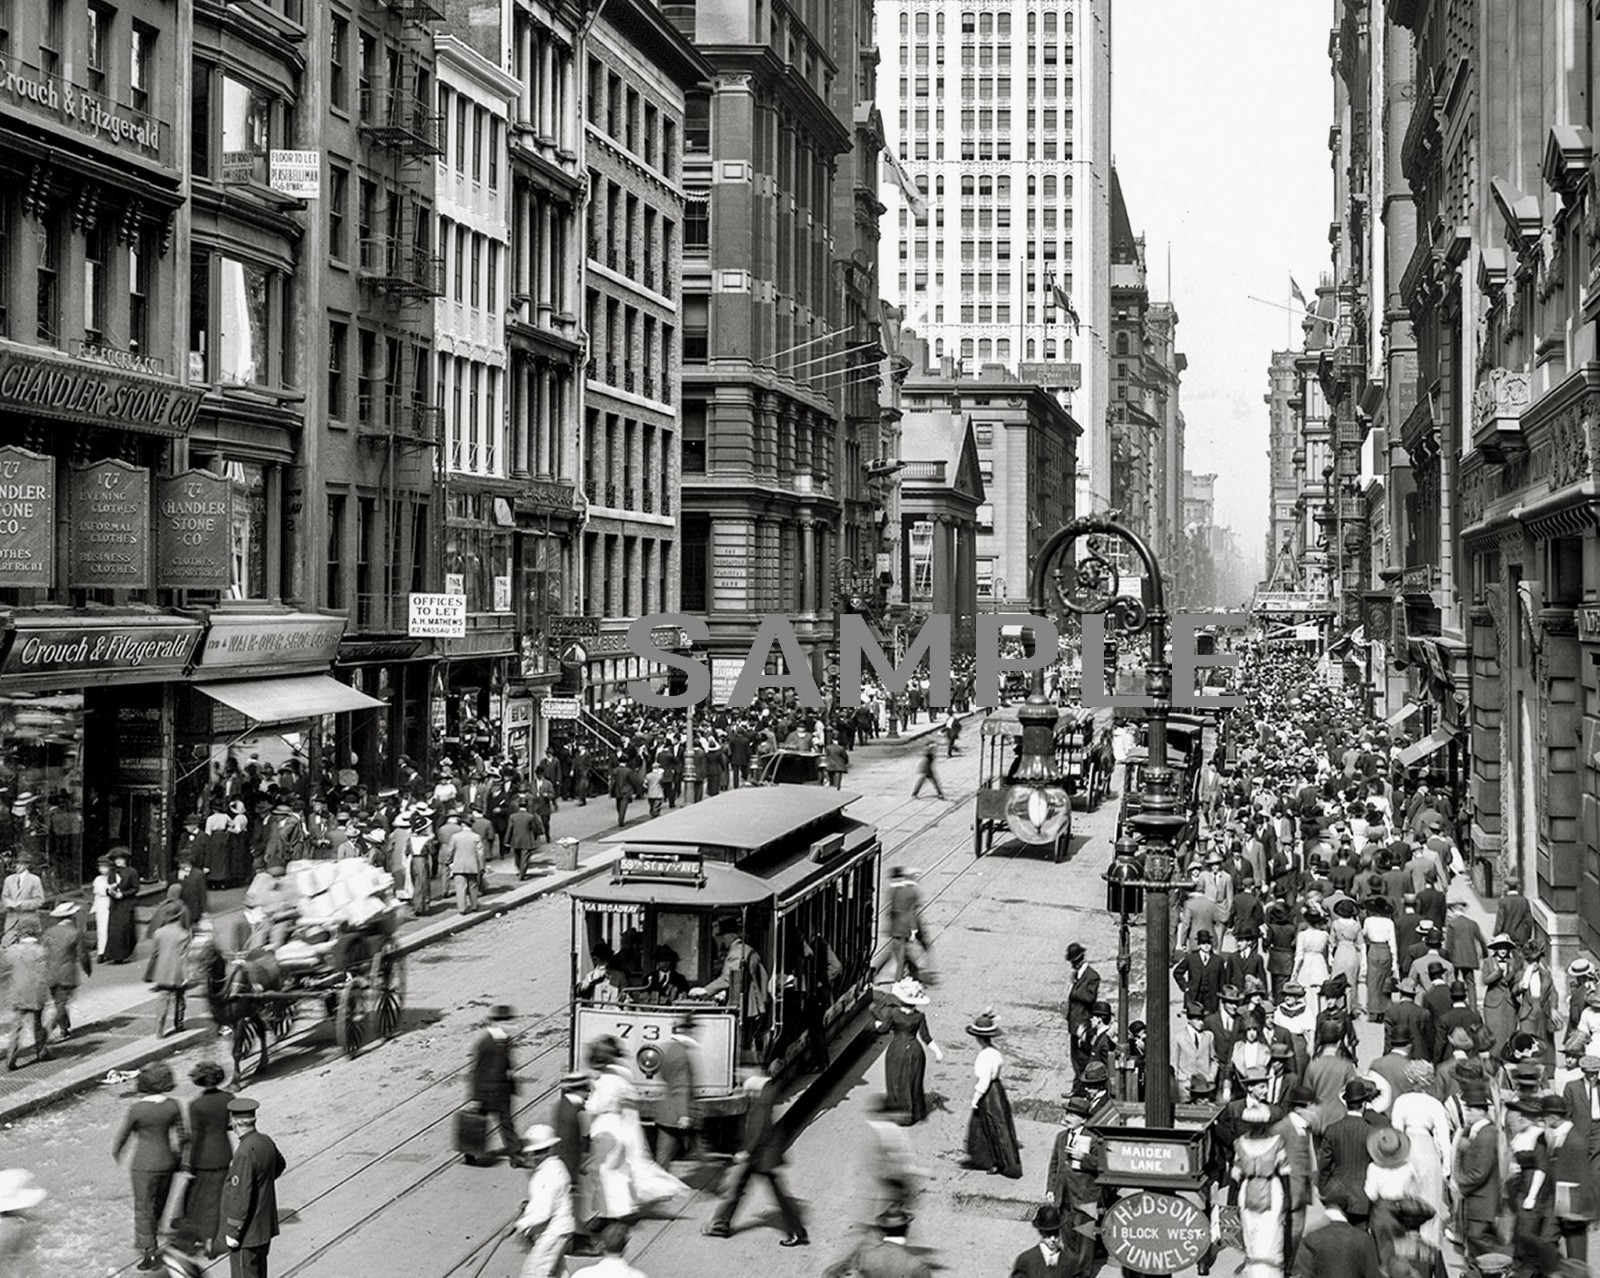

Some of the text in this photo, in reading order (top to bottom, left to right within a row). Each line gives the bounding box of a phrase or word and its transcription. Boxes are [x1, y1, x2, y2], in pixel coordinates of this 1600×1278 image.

[63, 87, 76, 118] &
[80, 93, 160, 150] Fitzgerald
[304, 153, 318, 165] LET
[1, 363, 109, 414] CHANDLER
[109, 386, 171, 424] STONE
[0, 460, 21, 479] 77
[98, 472, 121, 490] 177
[0, 484, 46, 500] NDLER
[183, 482, 203, 499] 177
[0, 502, 34, 518] ONE
[161, 499, 226, 518] CHANDLER
[171, 517, 215, 532] STONE
[90, 533, 138, 545] CLOTHES
[182, 532, 203, 547] CO
[0, 548, 32, 560] THES
[90, 563, 138, 574] CLOTHES
[412, 596, 463, 607] OFFICES
[415, 606, 459, 617] TO LET
[427, 618, 463, 627] MATHEWS
[21, 635, 89, 664] Crouch
[89, 635, 106, 662] &
[597, 903, 640, 914] BROADWAY
[1121, 1145, 1172, 1160] MAIDEN
[1130, 1159, 1163, 1172] LANE
[1113, 1194, 1199, 1227] HUDSON
[1120, 1227, 1160, 1239] BLOCK
[1167, 1228, 1203, 1240] WEST
[1114, 1238, 1199, 1270] TUNNELS
